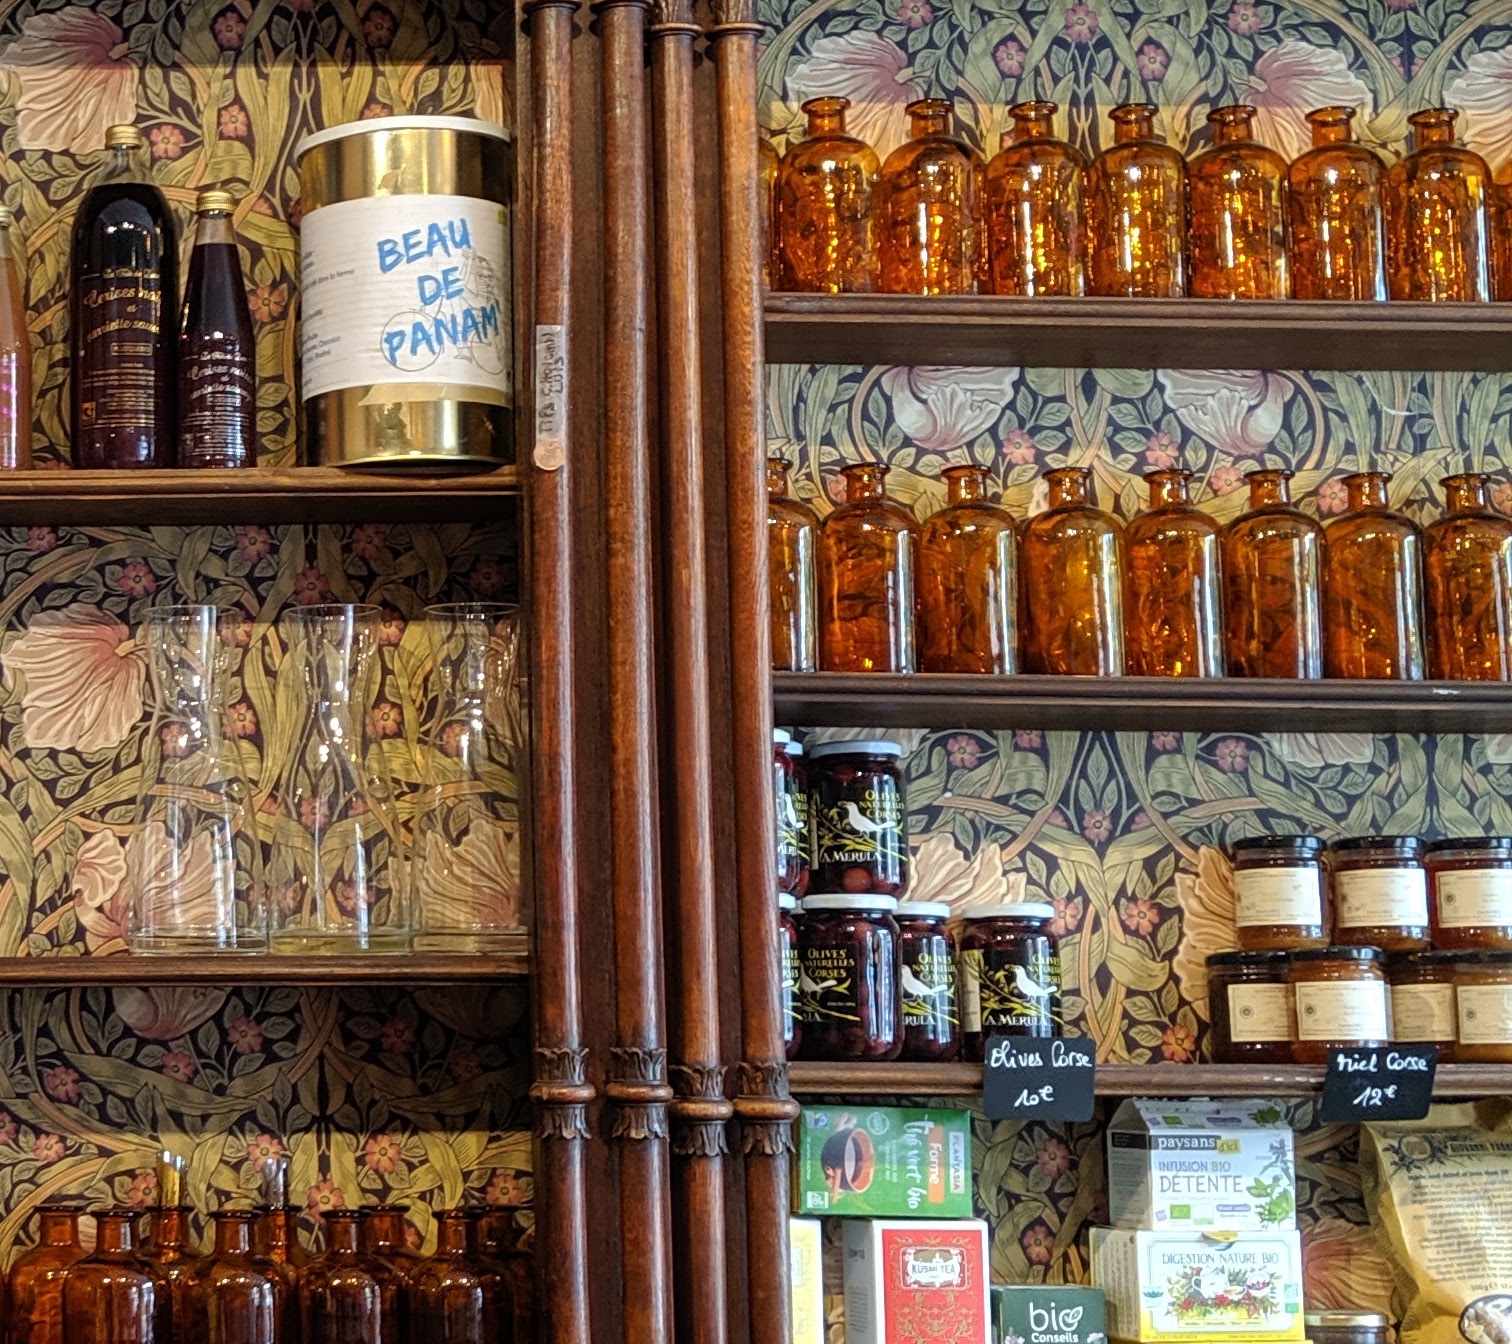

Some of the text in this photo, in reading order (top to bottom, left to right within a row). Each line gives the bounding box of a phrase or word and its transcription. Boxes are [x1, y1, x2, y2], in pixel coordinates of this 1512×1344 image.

[376, 217, 473, 274] BEAU
[417, 265, 465, 307] DE
[383, 296, 503, 367] PANAM'
[902, 1014, 936, 1027] RULA
[990, 1040, 1093, 1068] Olives Corse
[1386, 1051, 1429, 1072] Corse
[1013, 1085, 1055, 1108] 10€
[1351, 1084, 1399, 1108] 12€
[1157, 1136, 1216, 1151] paysans
[904, 1114, 934, 1209] thé vert bio
[928, 1142, 943, 1185] Forme
[952, 1134, 961, 1191] PLANTASIA
[1158, 1160, 1232, 1172] INFUSION BIO
[1159, 1172, 1244, 1193] DÉTENTE
[941, 1264, 956, 1275] TEA
[1162, 1252, 1279, 1265] DIGESTION NATURE BIO
[1029, 1301, 1084, 1332] bio
[1031, 1332, 1080, 1344] Conseils
